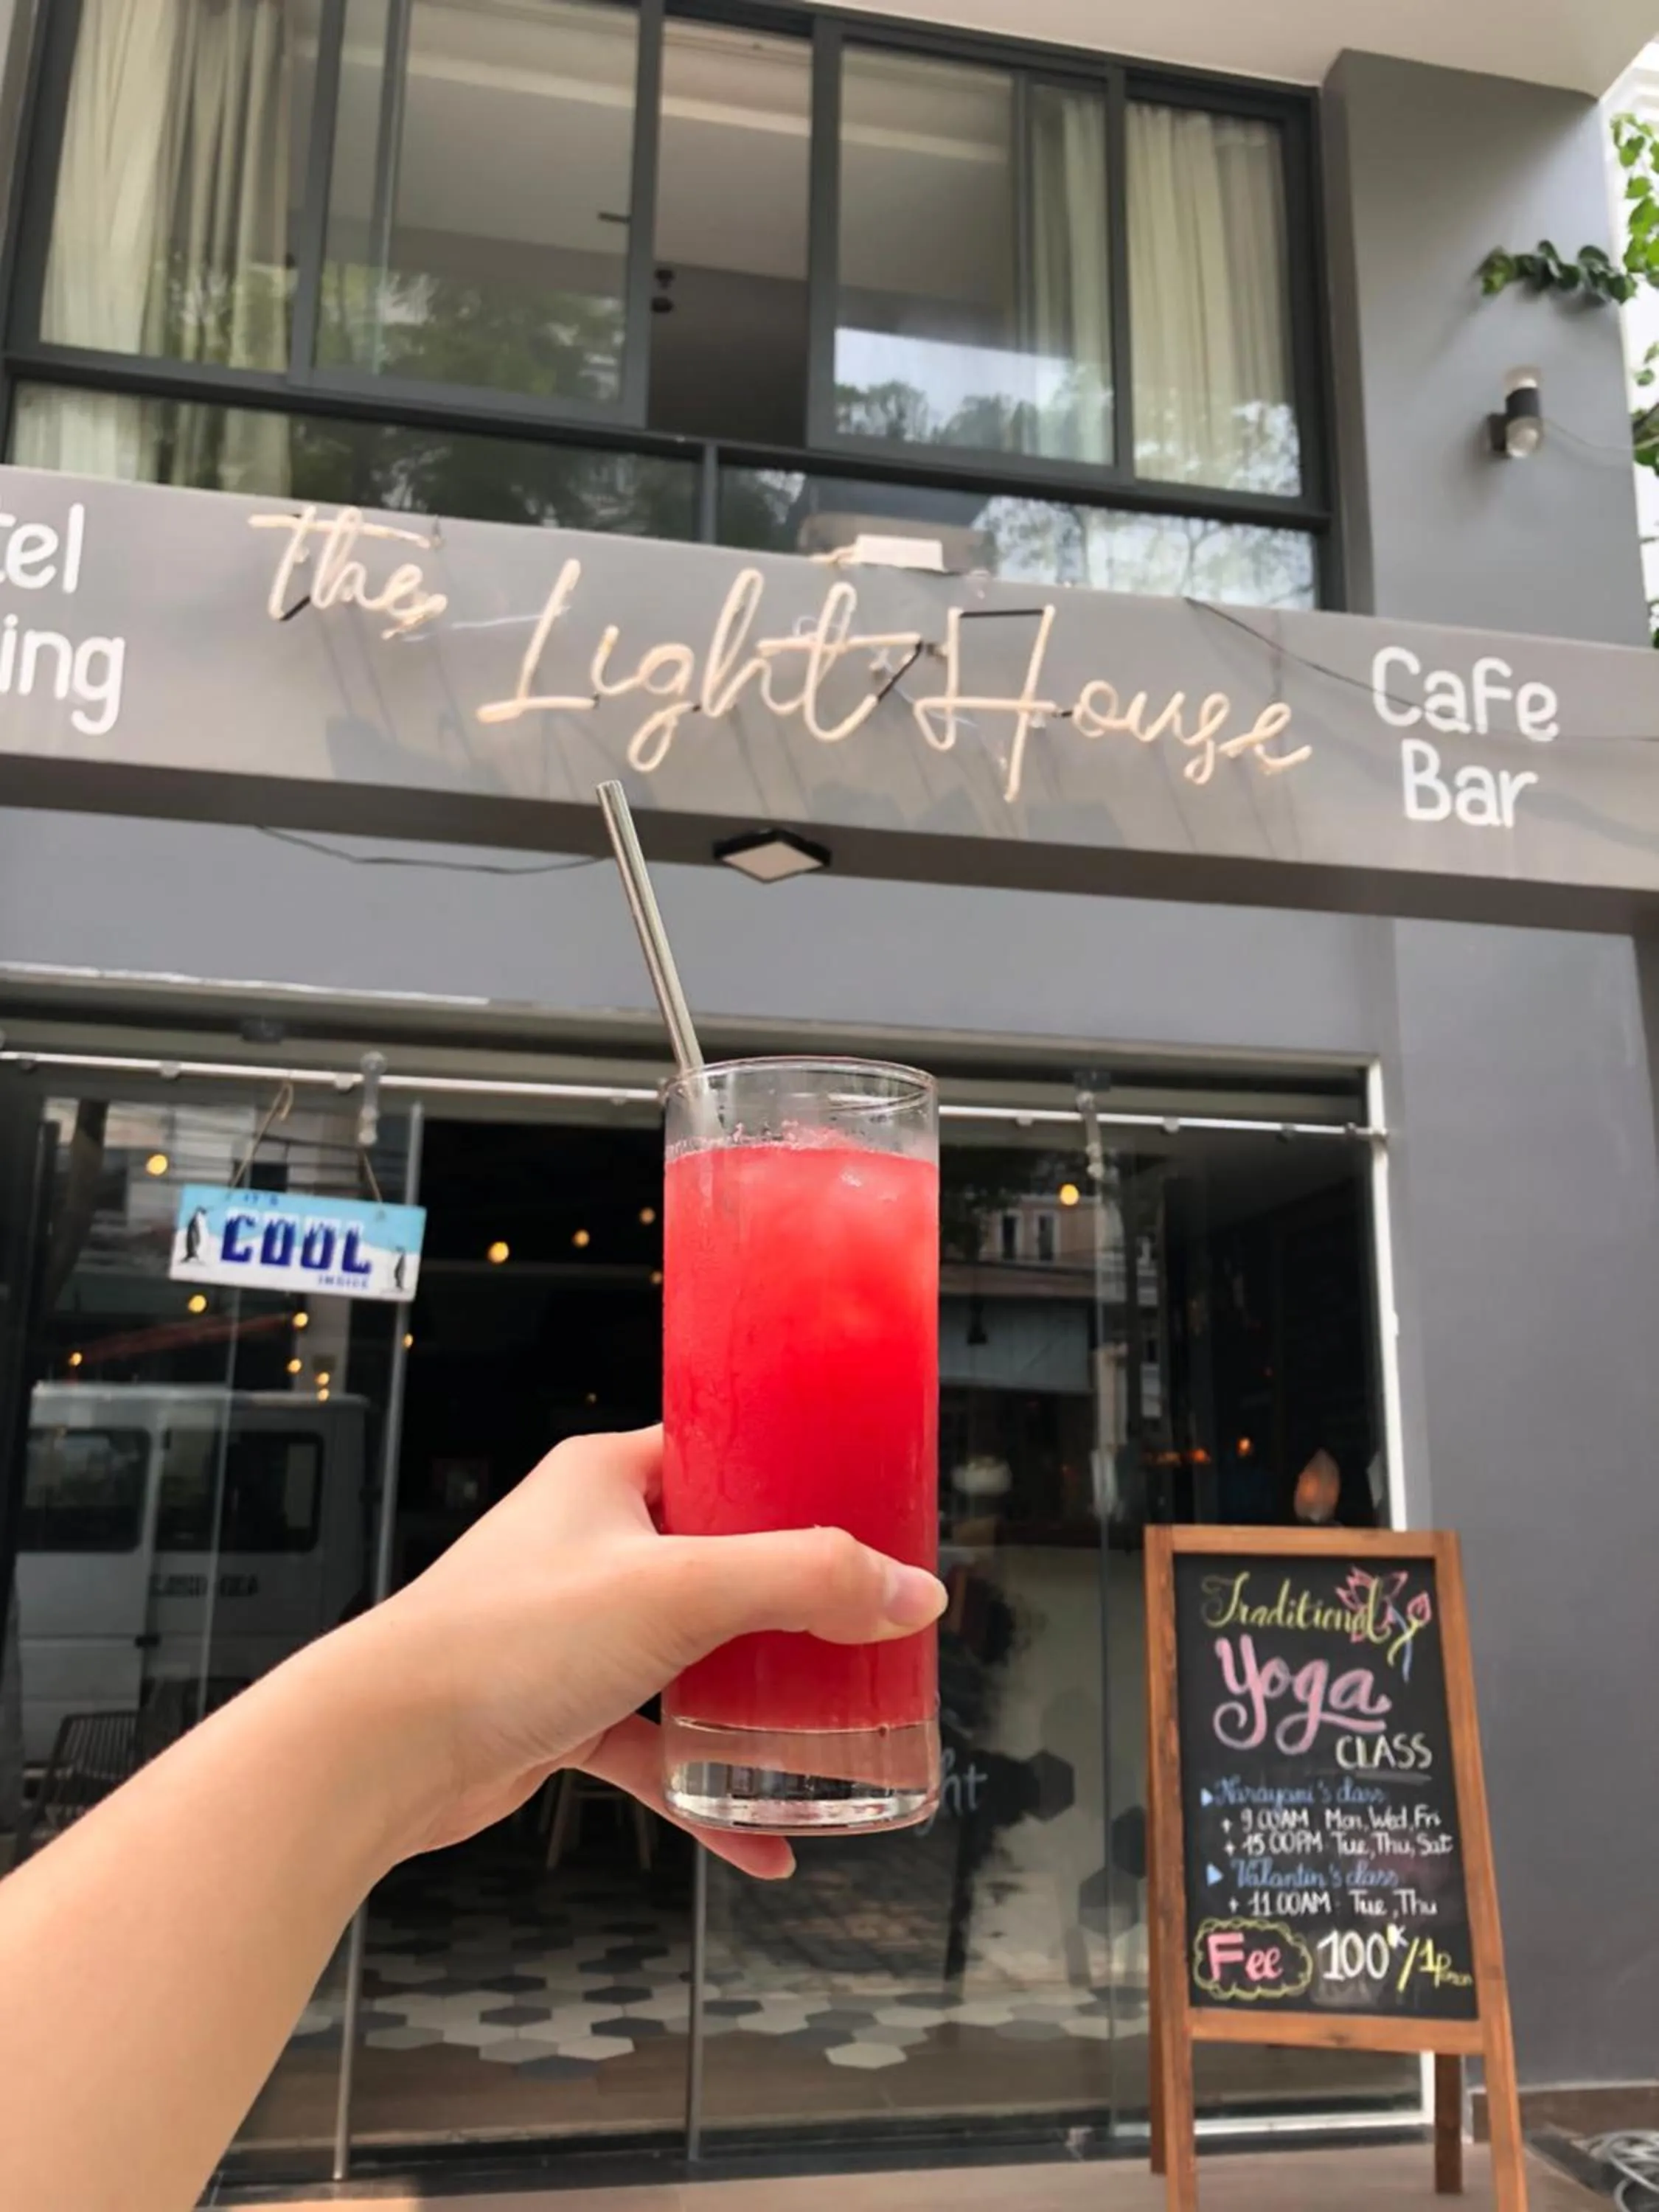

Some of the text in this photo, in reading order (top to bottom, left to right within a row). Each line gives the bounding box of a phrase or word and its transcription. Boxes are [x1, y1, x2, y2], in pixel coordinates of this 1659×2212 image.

[914, 605, 1311, 803] House
[1371, 645, 1559, 742] Cafe
[1402, 738, 1539, 829] Bar
[220, 1213, 372, 1275] COOL
[1213, 1634, 1392, 1756] Yoga
[1335, 1732, 1433, 1770] CLASS
[1206, 1932, 1284, 1980] Fee
